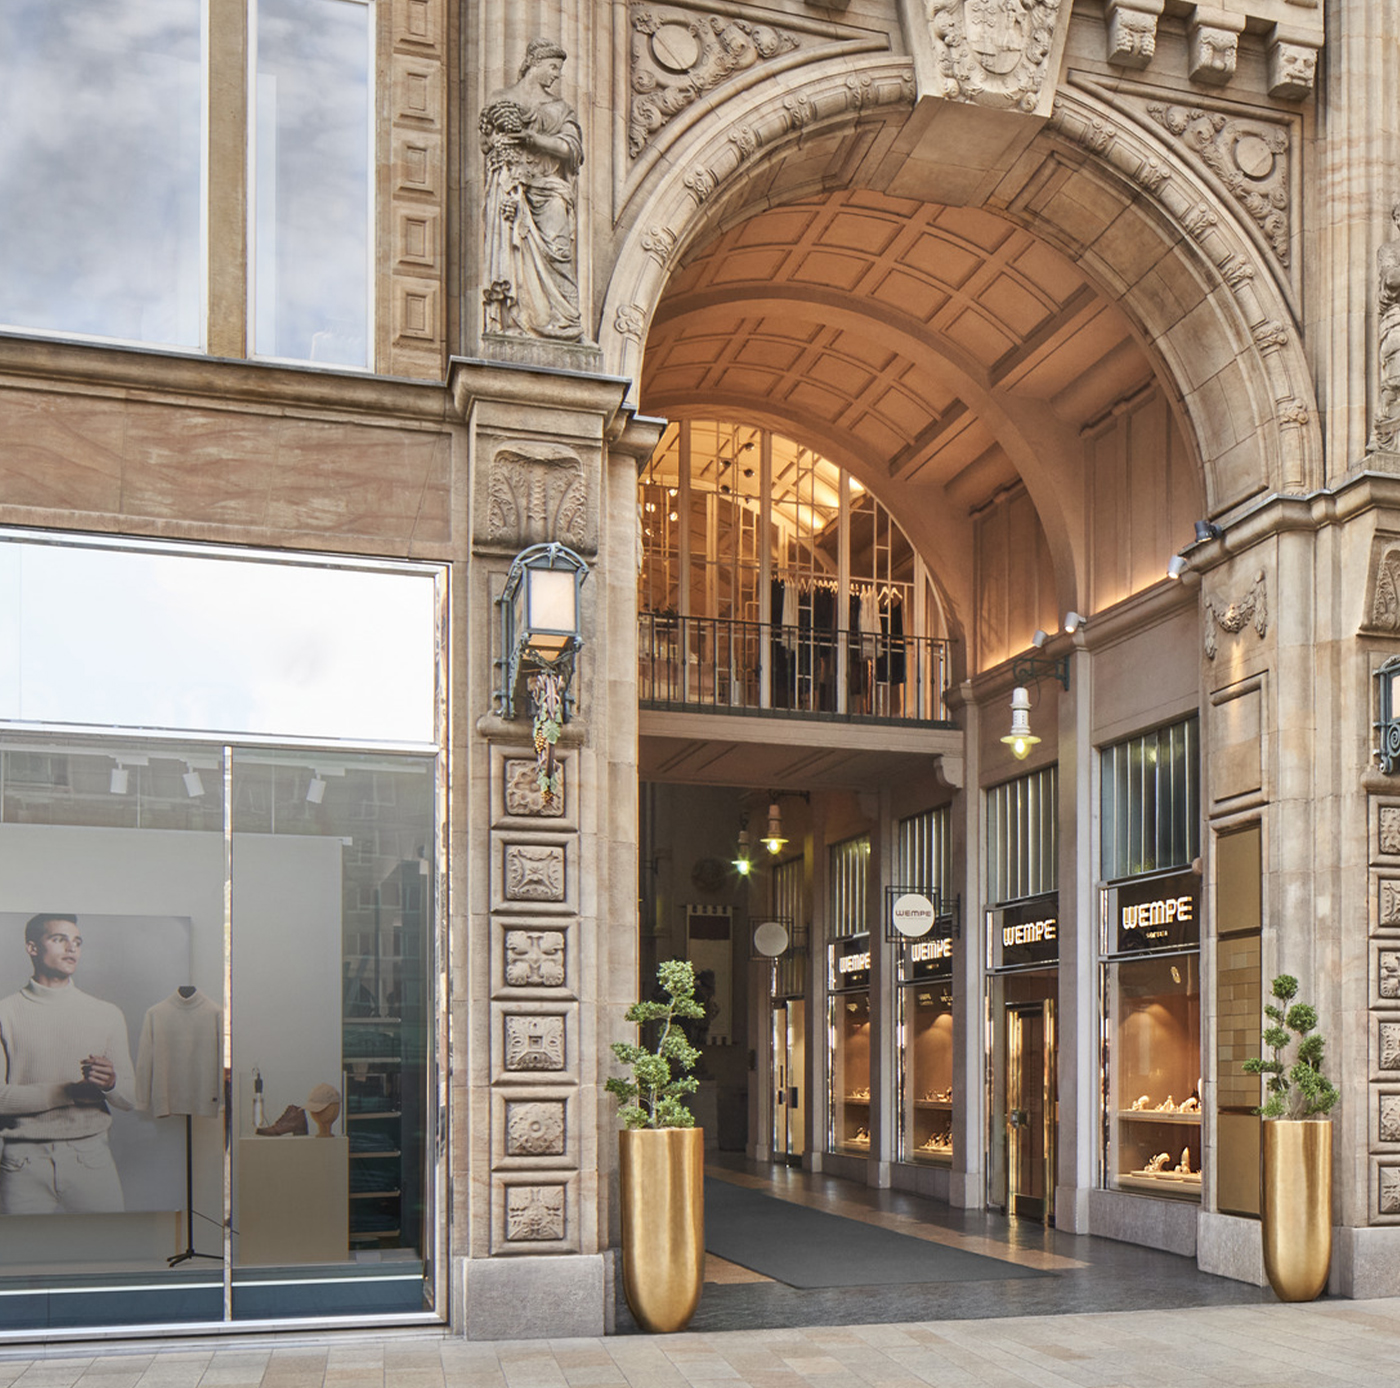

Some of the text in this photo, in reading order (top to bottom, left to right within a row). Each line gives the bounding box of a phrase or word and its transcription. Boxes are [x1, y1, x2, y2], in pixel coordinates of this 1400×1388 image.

[895, 909, 932, 917] WEMPE
[1122, 896, 1192, 930] WEMPE
[1003, 919, 1056, 947] WEMPE
[911, 938, 953, 962] WEMPE
[839, 952, 871, 973] WEMPE
